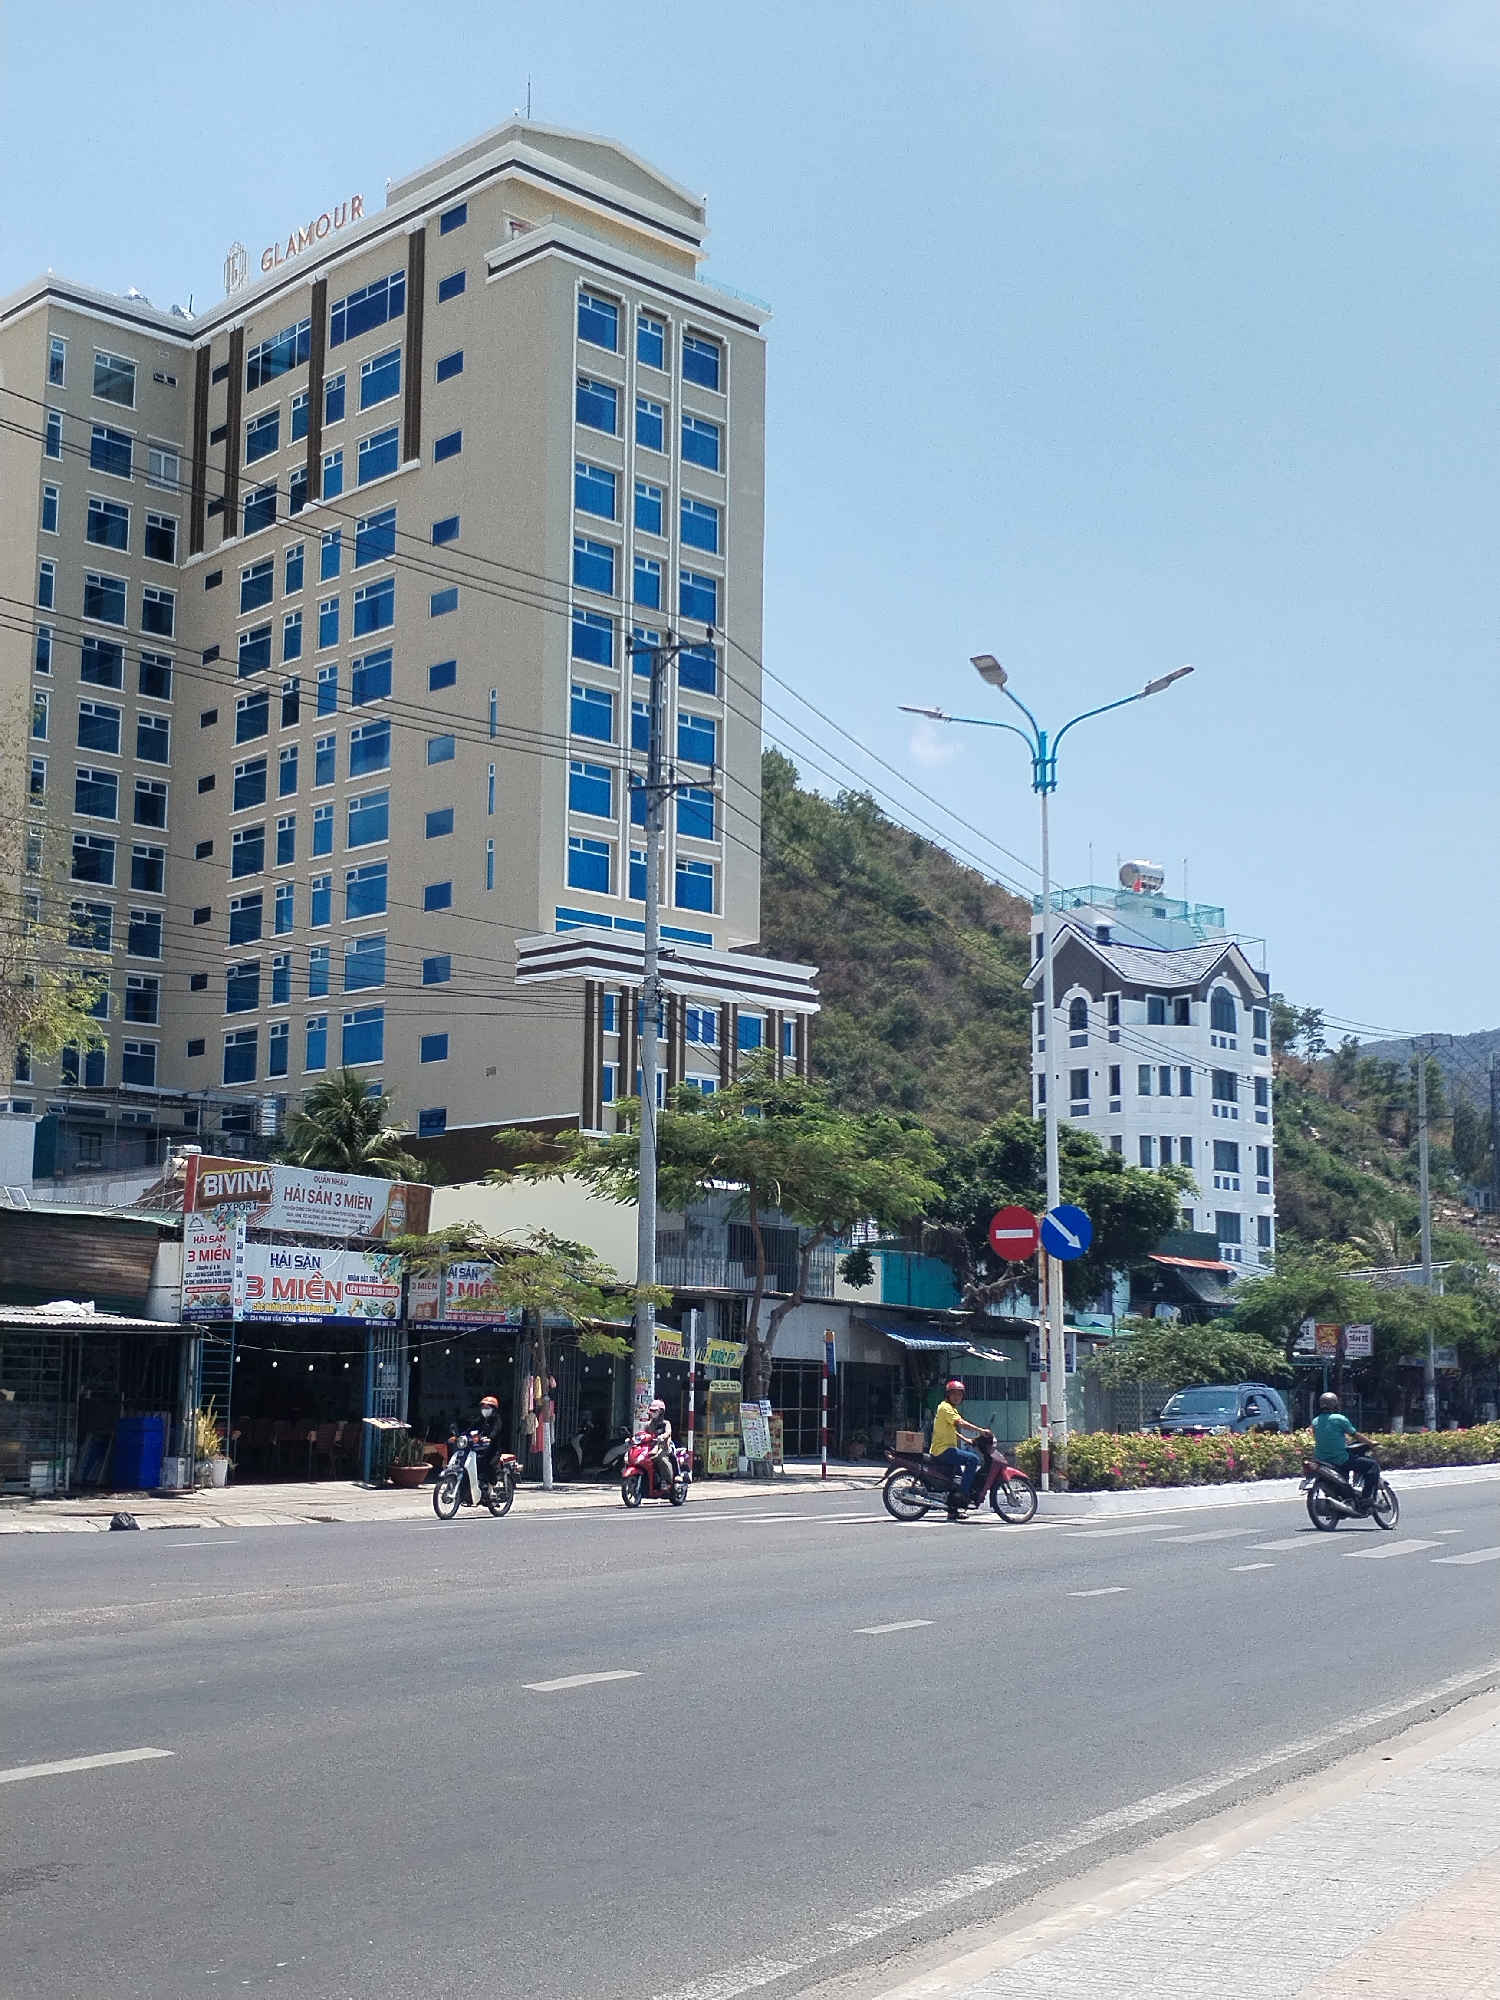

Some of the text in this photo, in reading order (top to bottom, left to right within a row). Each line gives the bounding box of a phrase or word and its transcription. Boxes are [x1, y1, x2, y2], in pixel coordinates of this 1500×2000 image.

[261, 195, 363, 272] GLAMOUR
[204, 1170, 272, 1197] BIVINA
[284, 1183, 373, 1211] HẢI SẢN 3 MIỀN
[219, 1201, 258, 1212] EXPORT
[193, 1232, 227, 1244] HẢI SẢN
[188, 1244, 231, 1262] 3 MIỀN
[270, 1250, 322, 1270] HẢI SẢN
[447, 1263, 479, 1280] ẢI SẢN
[245, 1270, 344, 1303] 3 MIỀN
[412, 1280, 438, 1290] 3 MIỀN
[446, 1281, 454, 1297] 3
[658, 1340, 681, 1358] COFFEE
